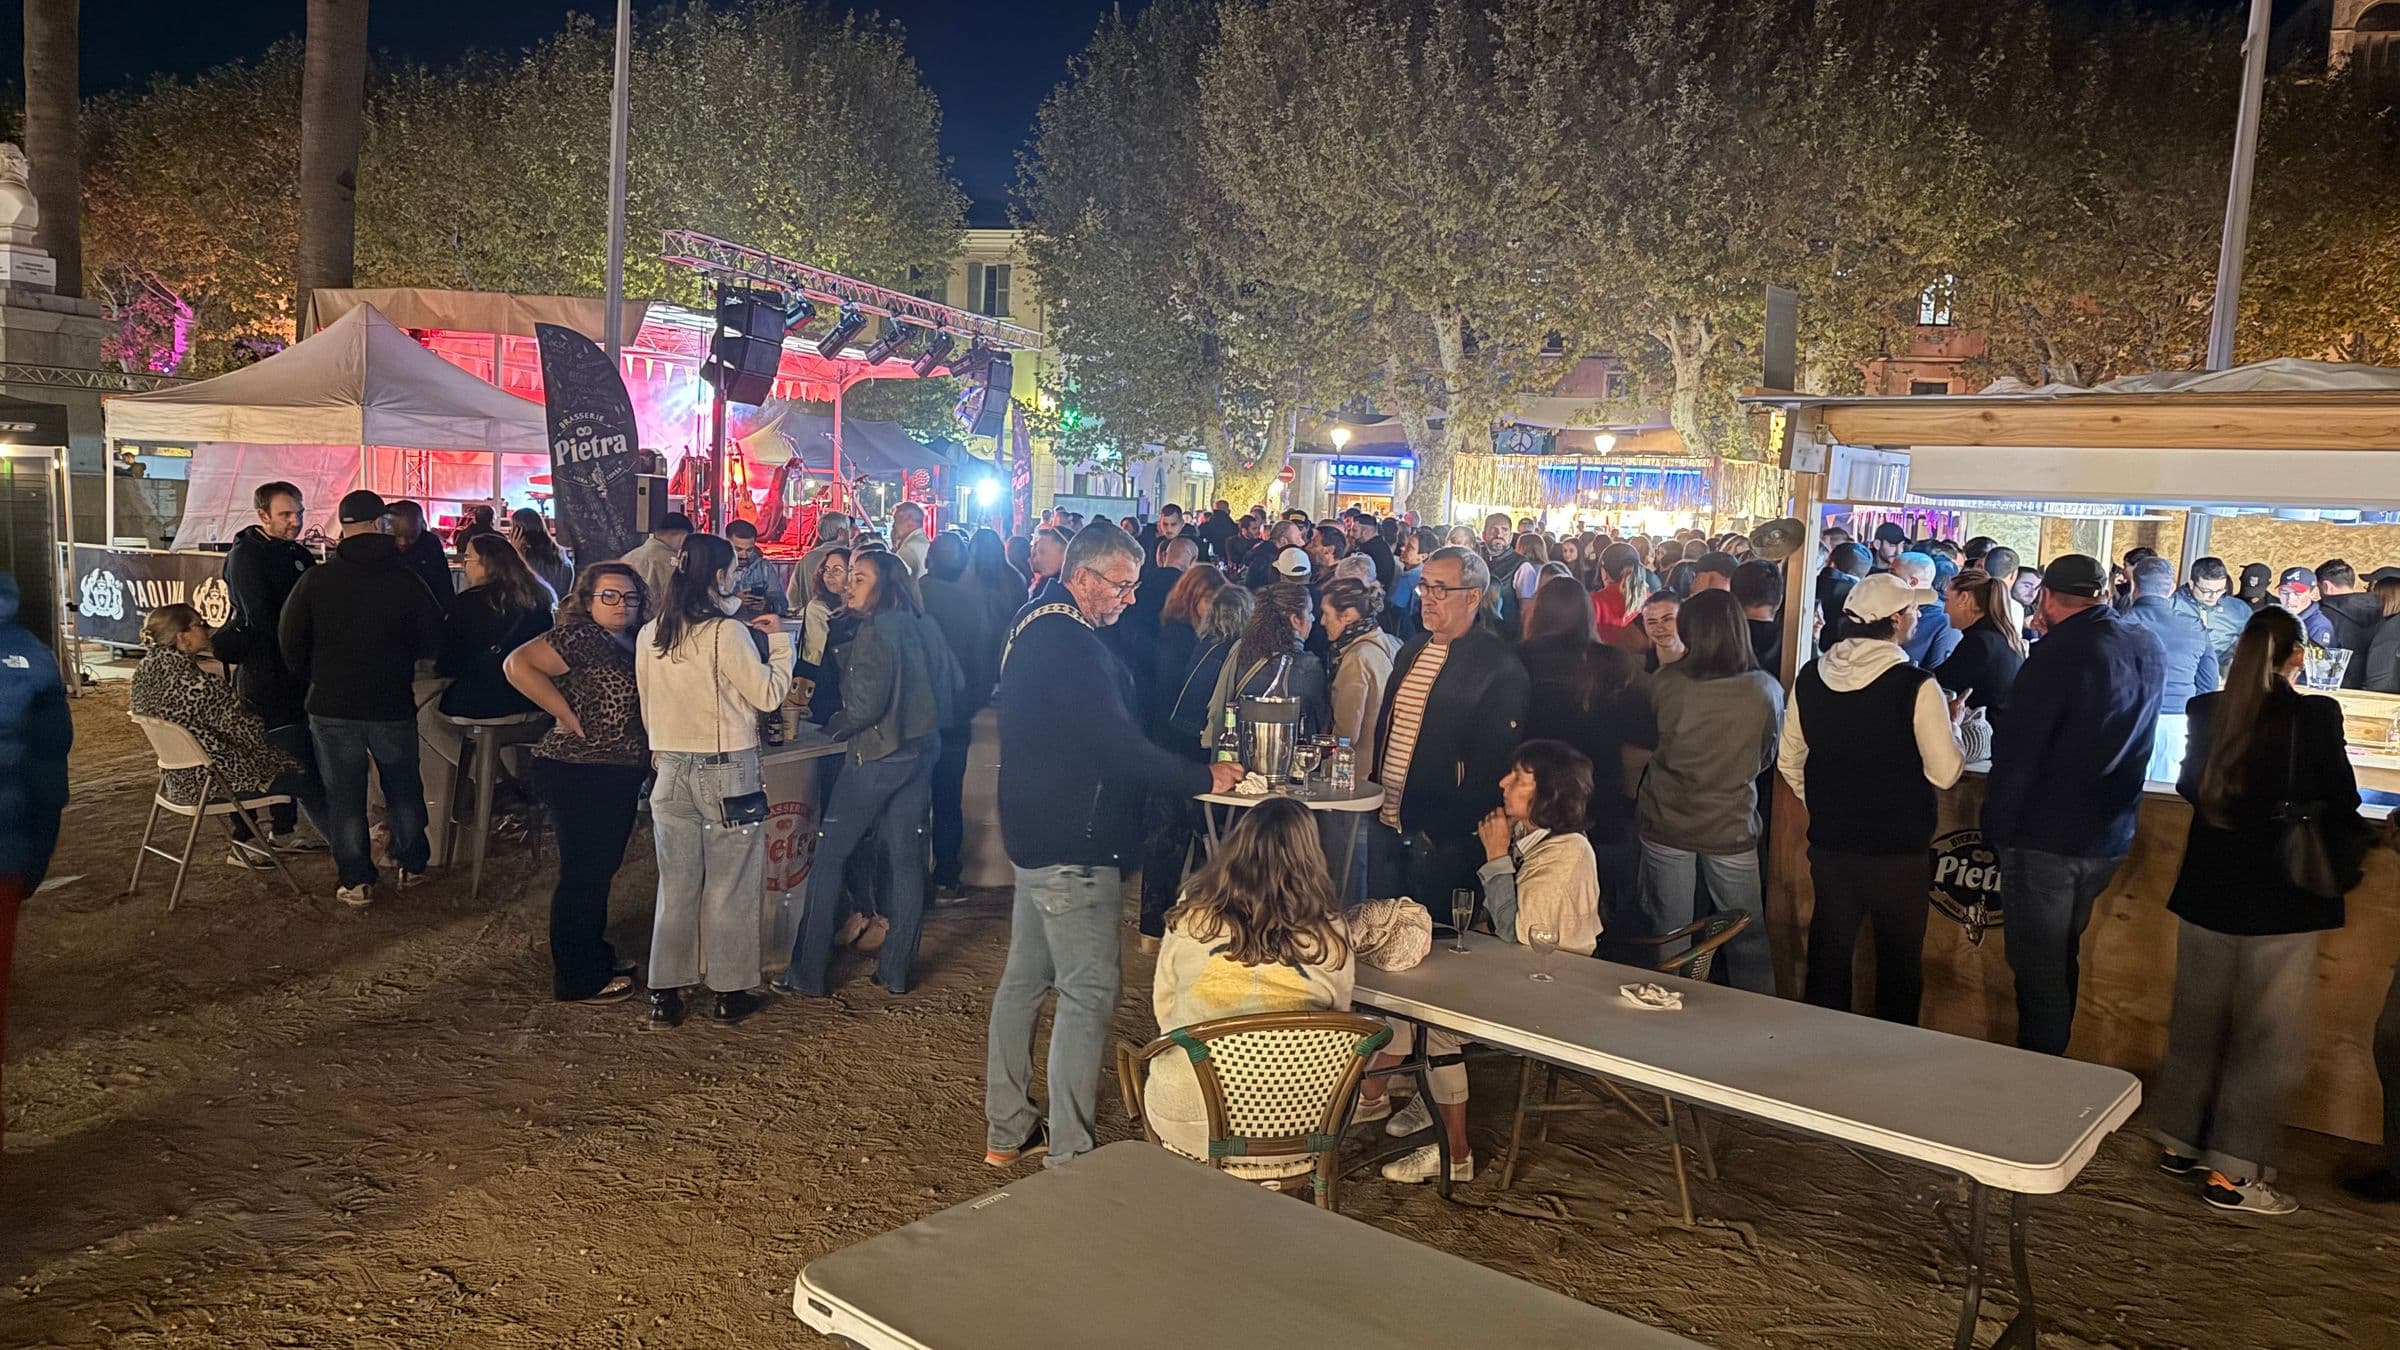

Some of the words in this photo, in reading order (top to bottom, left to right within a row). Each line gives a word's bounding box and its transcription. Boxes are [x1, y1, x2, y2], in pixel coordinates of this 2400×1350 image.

[558, 412, 605, 430] BRASSERIE
[554, 433, 628, 467] Pietra
[1330, 464, 1345, 476] LE
[1345, 464, 1394, 478] GLACIER
